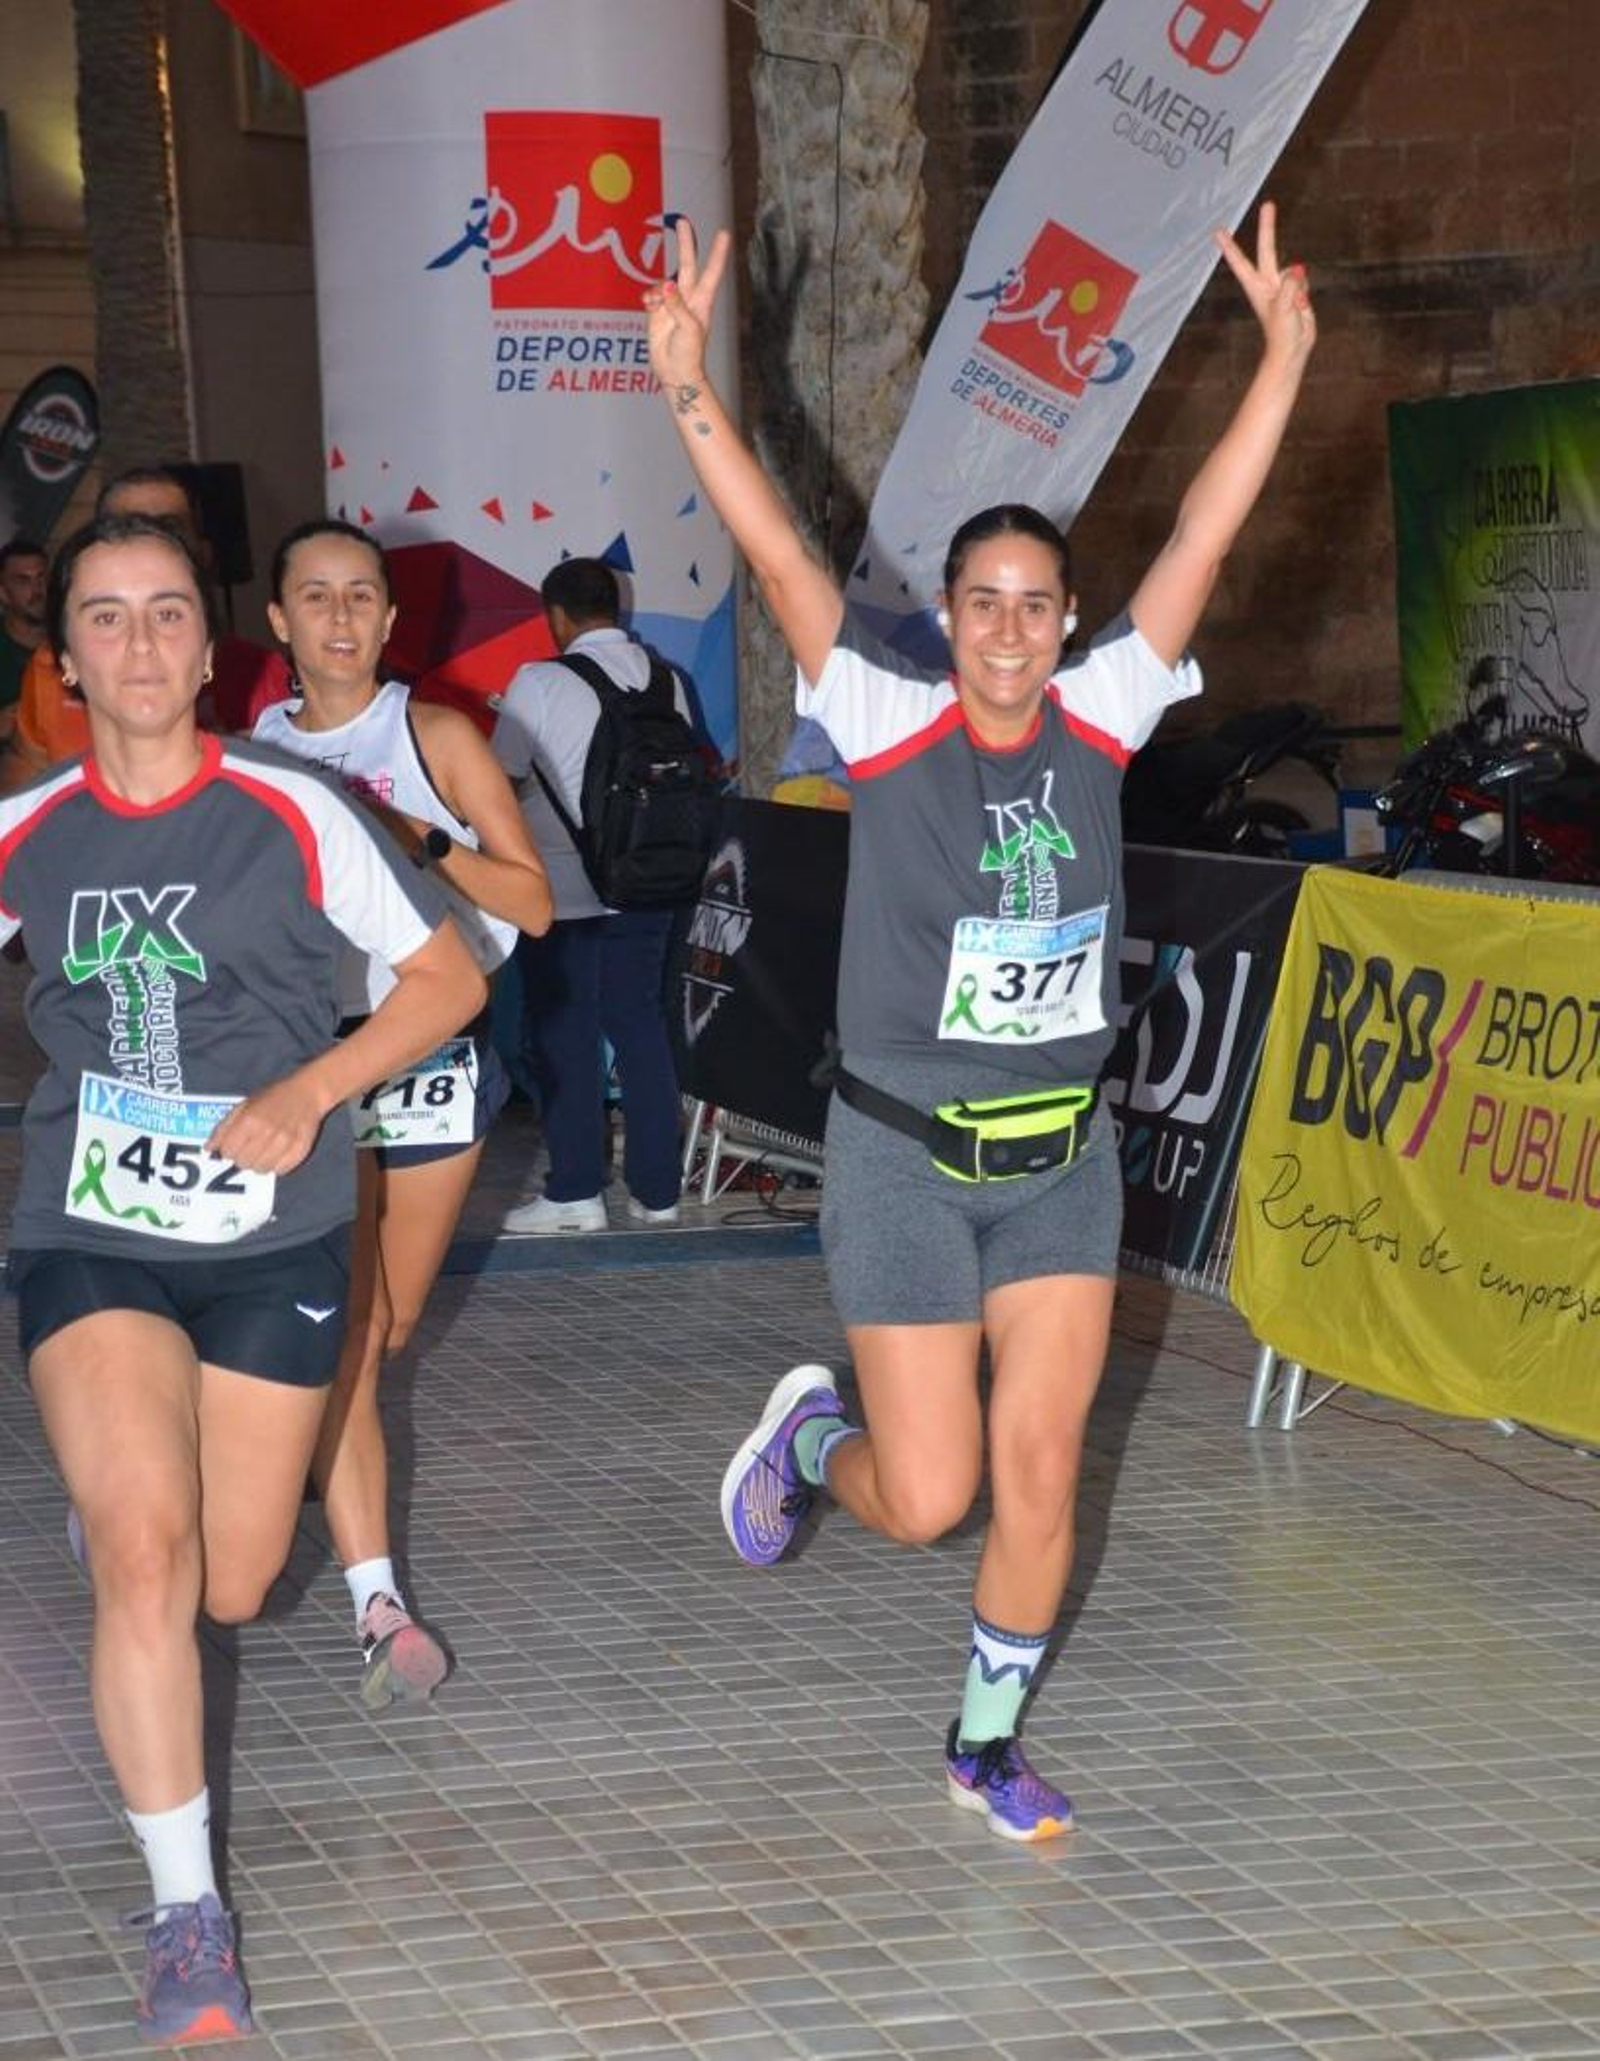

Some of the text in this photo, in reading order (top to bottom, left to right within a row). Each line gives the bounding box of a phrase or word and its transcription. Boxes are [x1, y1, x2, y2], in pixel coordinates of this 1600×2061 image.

[1095, 57, 1235, 167] ALMERÍA
[1112, 110, 1187, 169] CIUDAD
[496, 336, 650, 364] DEPORTE
[583, 320, 648, 333] MUNICIPA
[496, 369, 537, 393] DE
[950, 378, 975, 401] DE
[961, 357, 1070, 430] DEPORTES
[1472, 464, 1560, 528] CARRERA
[67, 884, 197, 967] IX
[991, 951, 1087, 1004] 377
[1289, 942, 1446, 1147] BGP
[88, 1080, 127, 1120] IX
[126, 1093, 188, 1118] CARRERA
[117, 1135, 246, 1195] 452
[1418, 1227, 1462, 1275] de
